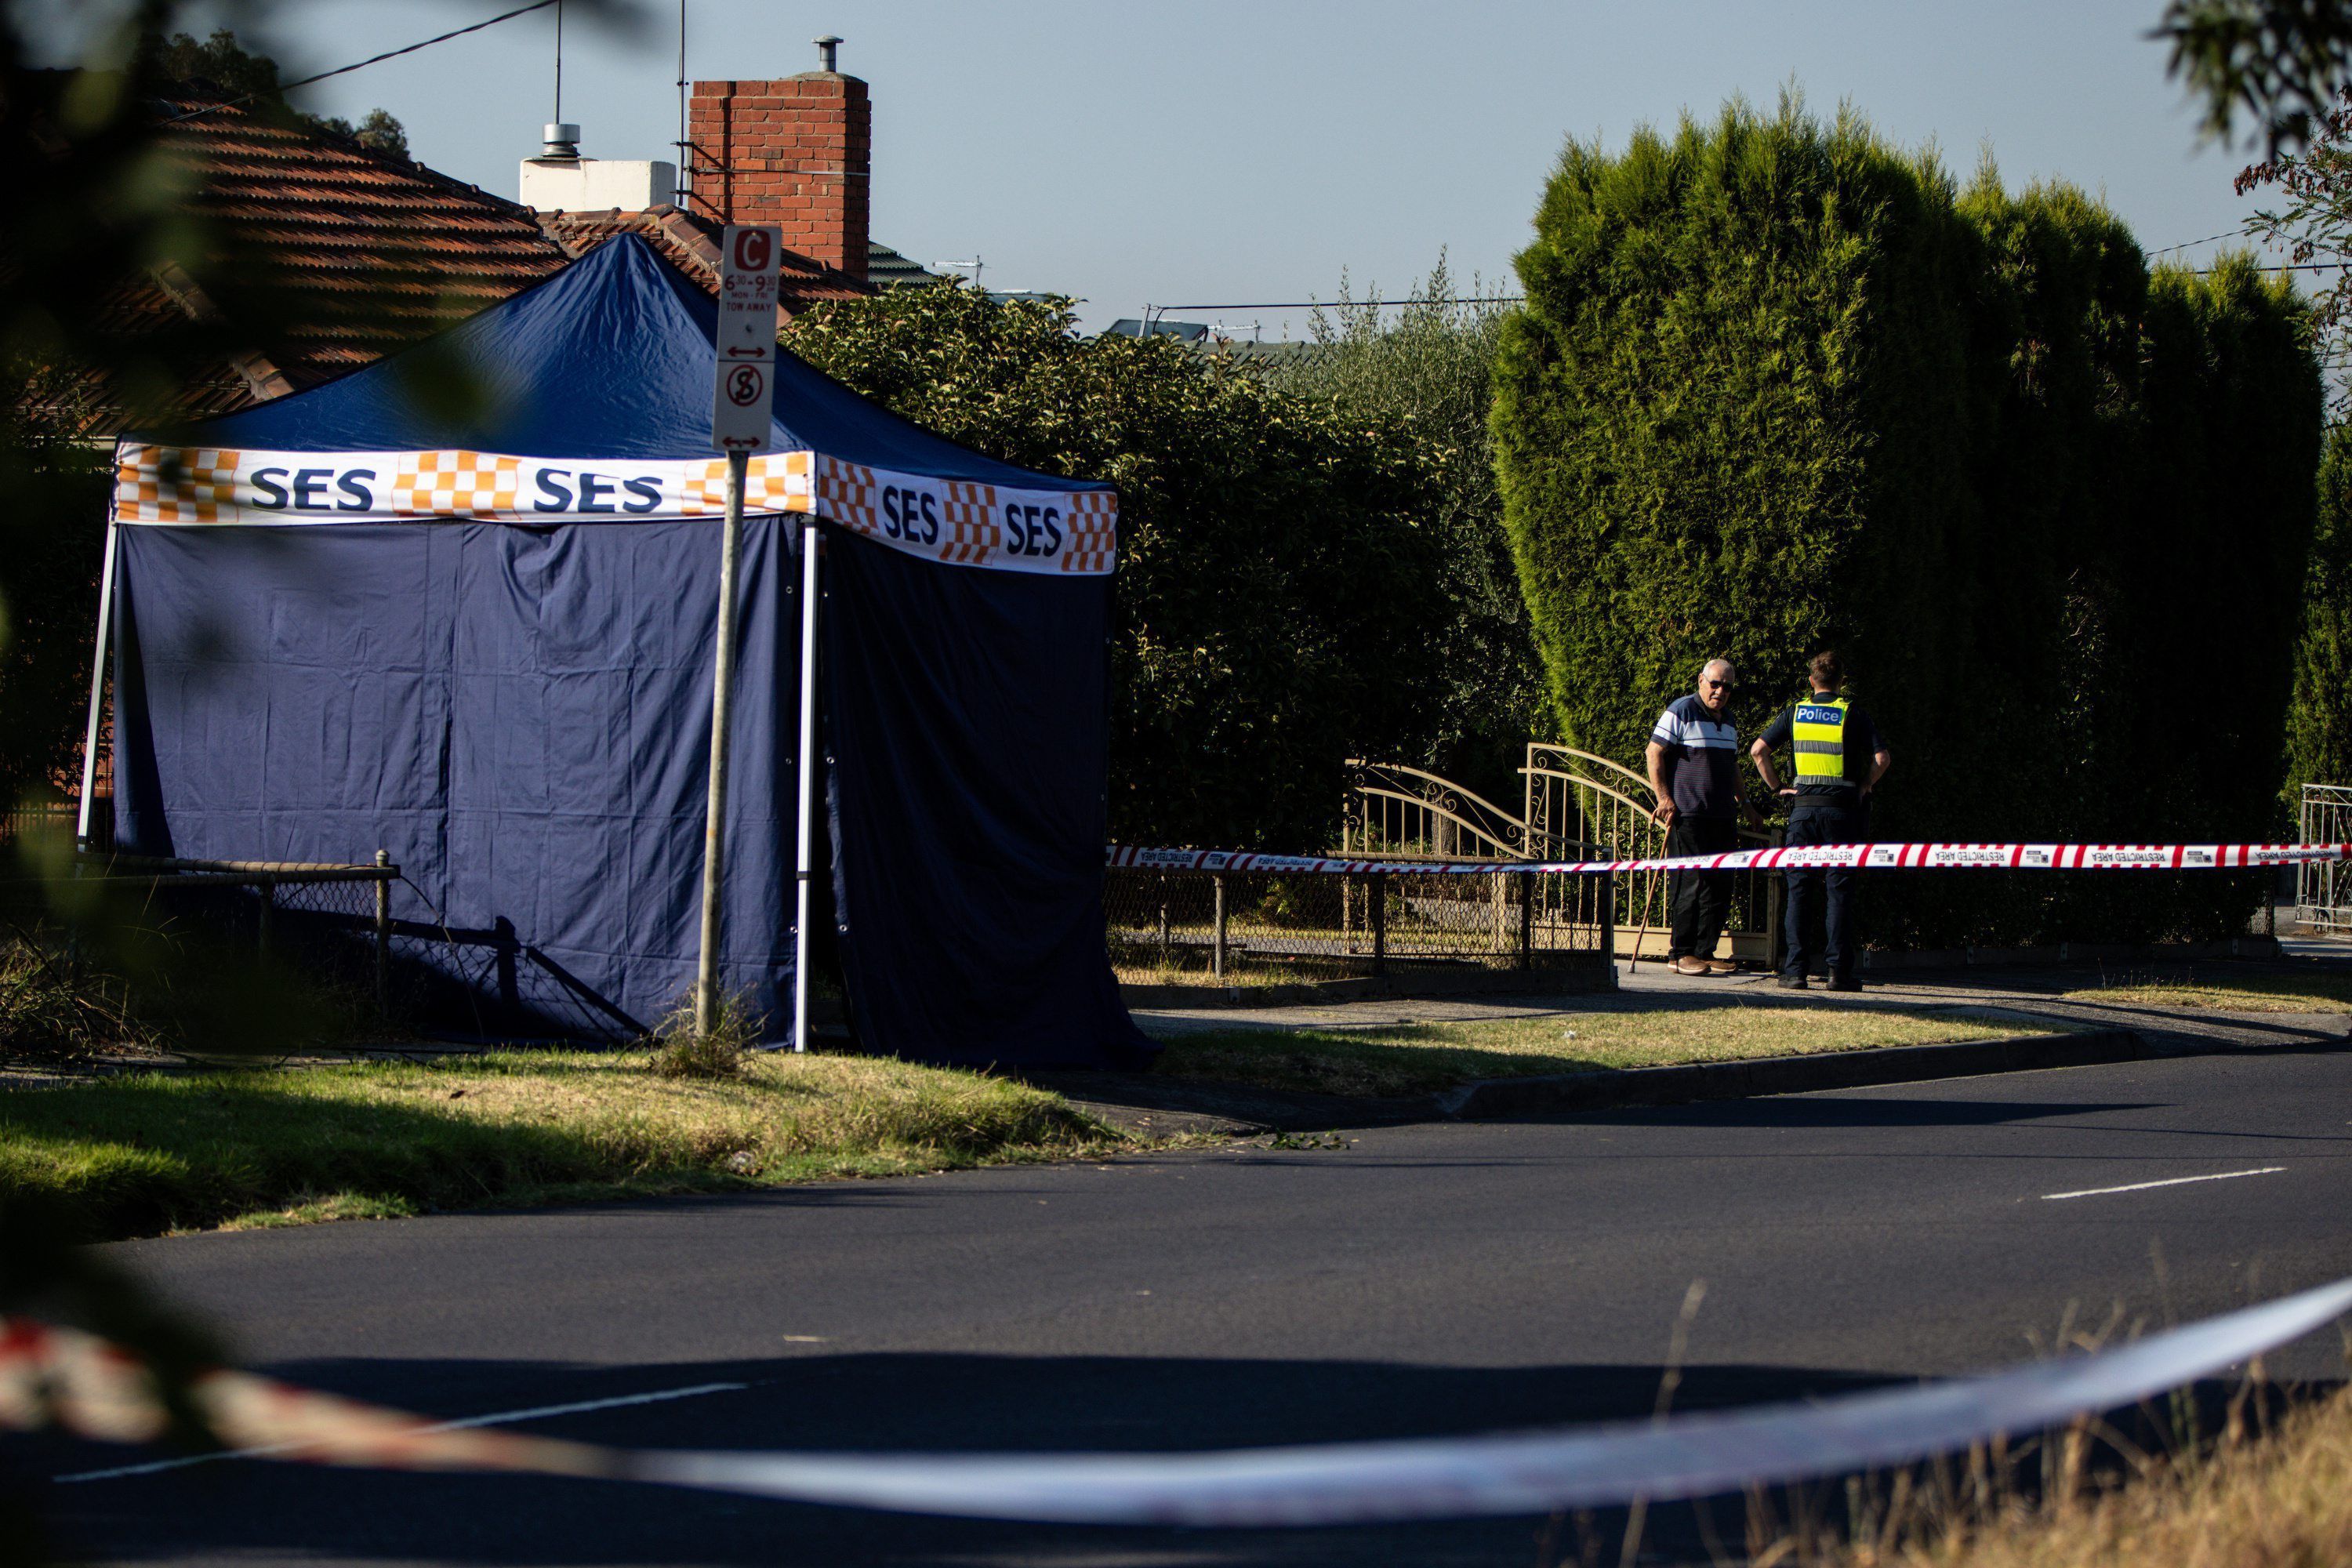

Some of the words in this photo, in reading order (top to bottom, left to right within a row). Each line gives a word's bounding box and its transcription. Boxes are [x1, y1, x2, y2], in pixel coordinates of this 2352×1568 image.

[742, 234, 763, 267] C
[726, 302, 744, 312] TOW
[746, 303, 771, 312] AWAY
[250, 467, 376, 512] SES
[534, 467, 662, 514] SES
[882, 485, 938, 546] SES
[1005, 503, 1062, 557] SES
[1797, 708, 1839, 722] Police
[1141, 851, 1157, 861] AREA
[1157, 852, 1193, 862] RESTRICTED
[1788, 851, 1807, 861] AREA
[1808, 851, 1853, 861] RESTRICTED
[1935, 851, 1955, 861] AREA
[1957, 851, 2005, 862] RESTRICTED
[2092, 852, 2113, 862] AREA
[2115, 852, 2165, 862] RESTRICTED
[2281, 851, 2336, 859] RESTRICTED
